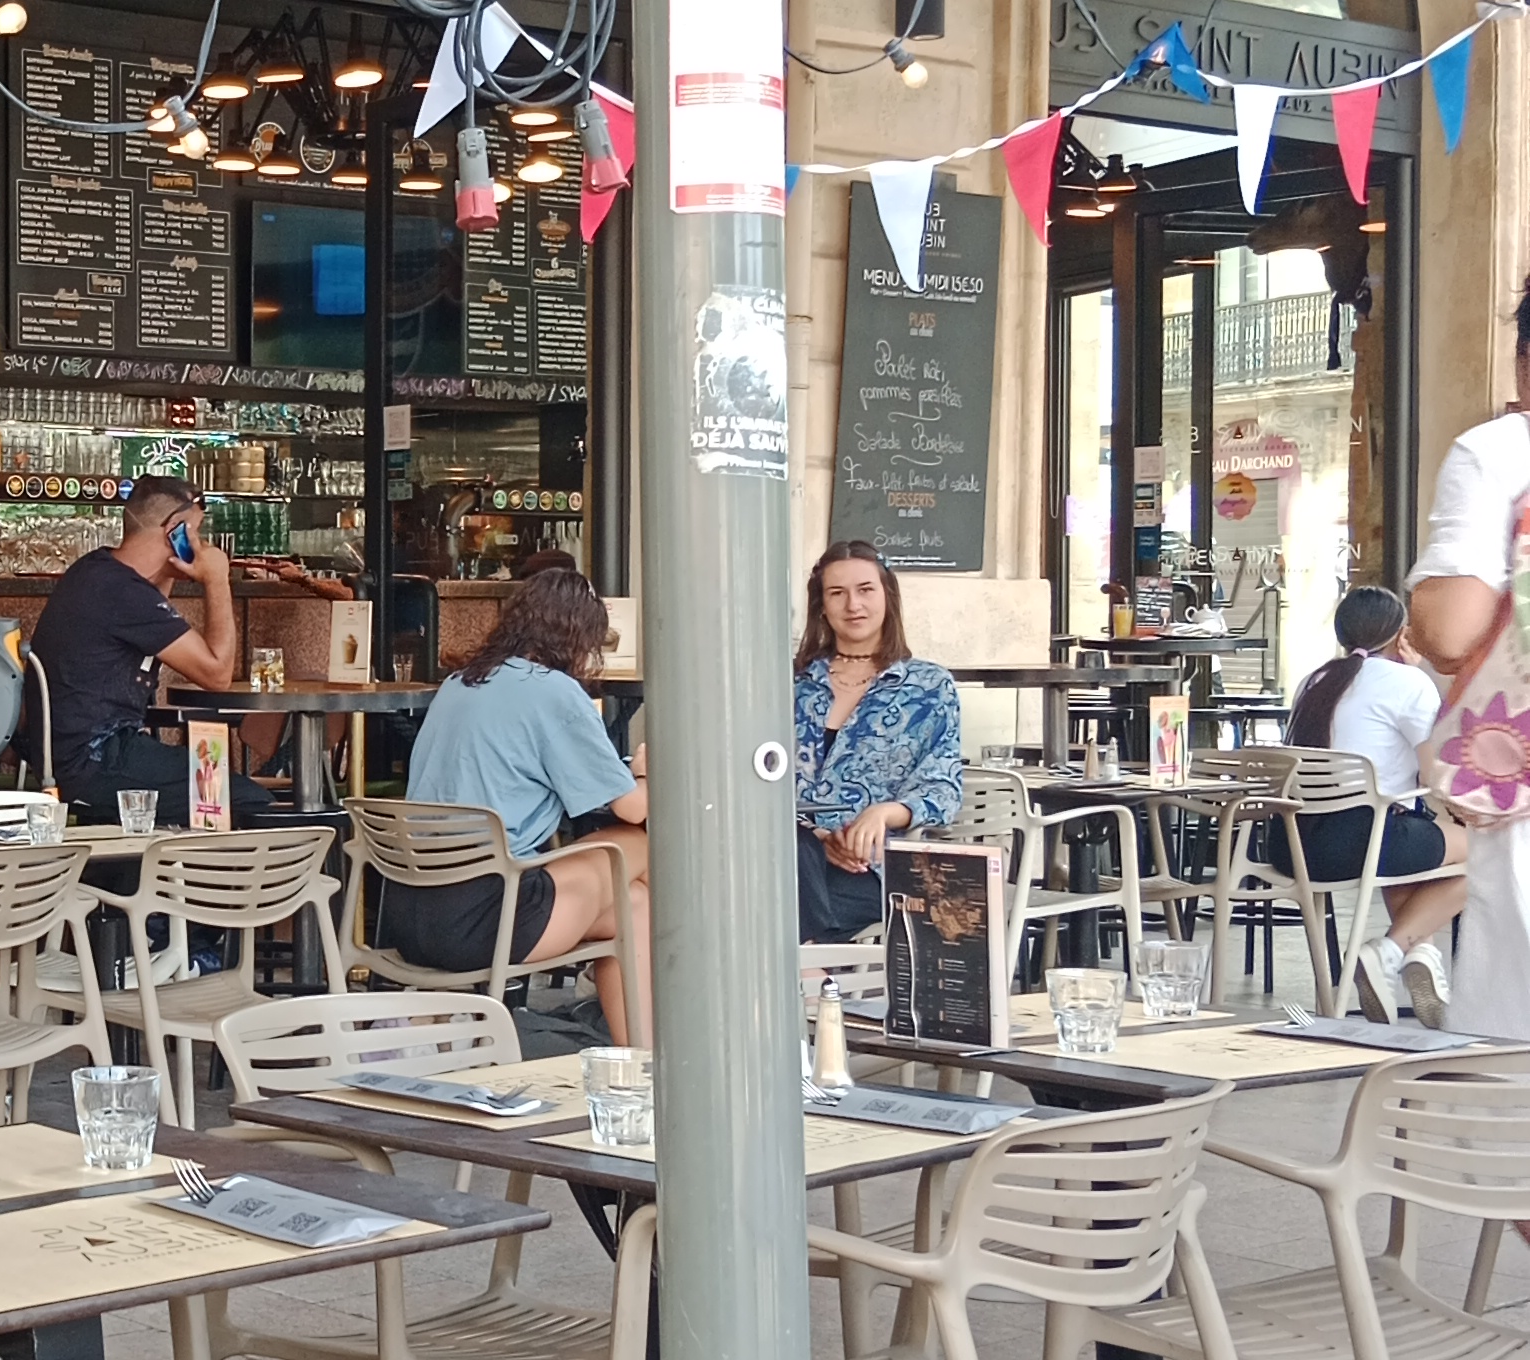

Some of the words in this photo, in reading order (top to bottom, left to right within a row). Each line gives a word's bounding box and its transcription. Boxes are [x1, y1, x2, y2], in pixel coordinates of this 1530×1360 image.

[1049, 2, 1100, 52] UB
[1134, 10, 1261, 78] SINT
[1285, 40, 1400, 100] AUBIN
[925, 202, 941, 217] UB
[925, 218, 946, 233] INT
[863, 269, 900, 287] MENU
[924, 273, 949, 291] MIDI
[908, 312, 936, 328] PLATS
[859, 385, 911, 411] pommes
[703, 415, 727, 429] ILS
[692, 428, 745, 449] DÉJÀ
[749, 433, 788, 453] SAUV
[853, 423, 901, 453] Salade
[1231, 454, 1294, 472] DARCHAND
[949, 474, 981, 493] salade
[888, 492, 937, 508] DESSERTS
